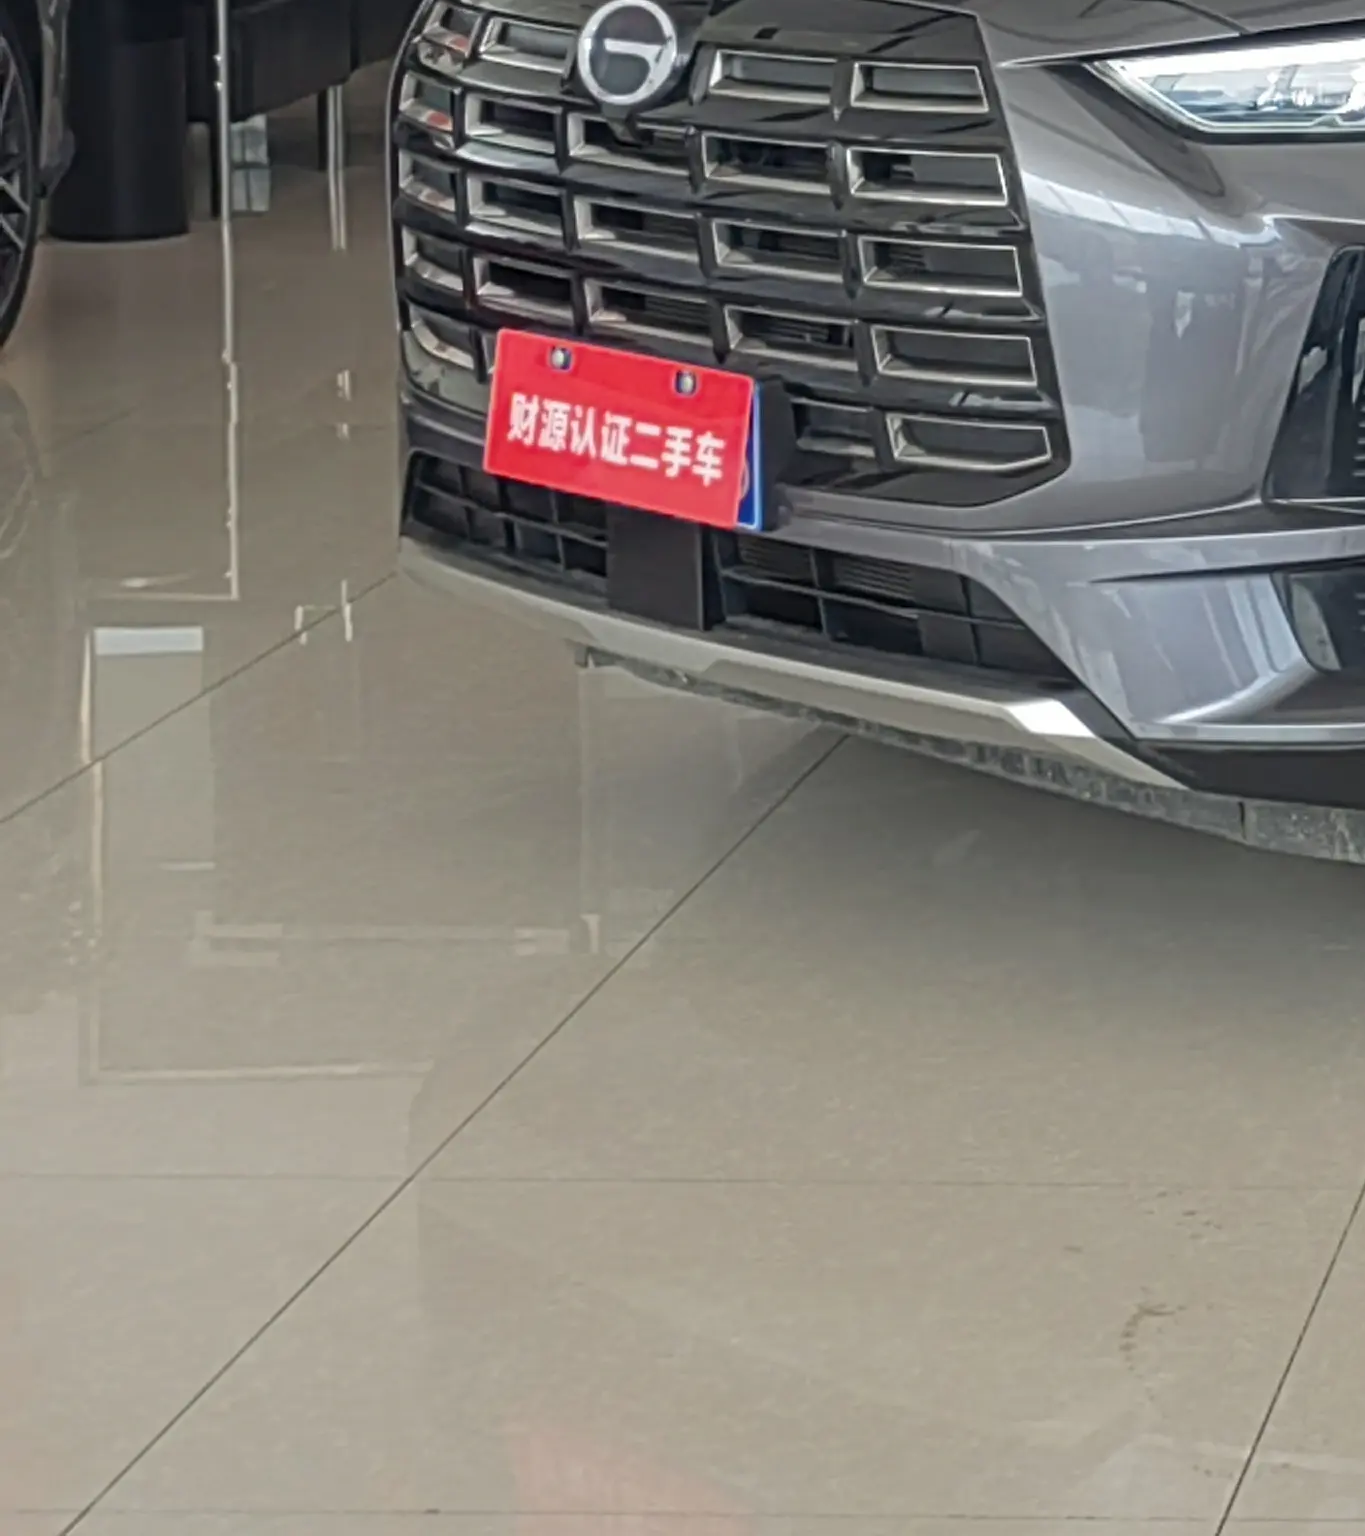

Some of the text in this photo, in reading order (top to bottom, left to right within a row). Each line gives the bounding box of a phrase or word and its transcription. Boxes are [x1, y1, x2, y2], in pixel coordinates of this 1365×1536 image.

[507, 391, 726, 487] 财源认证二手车
